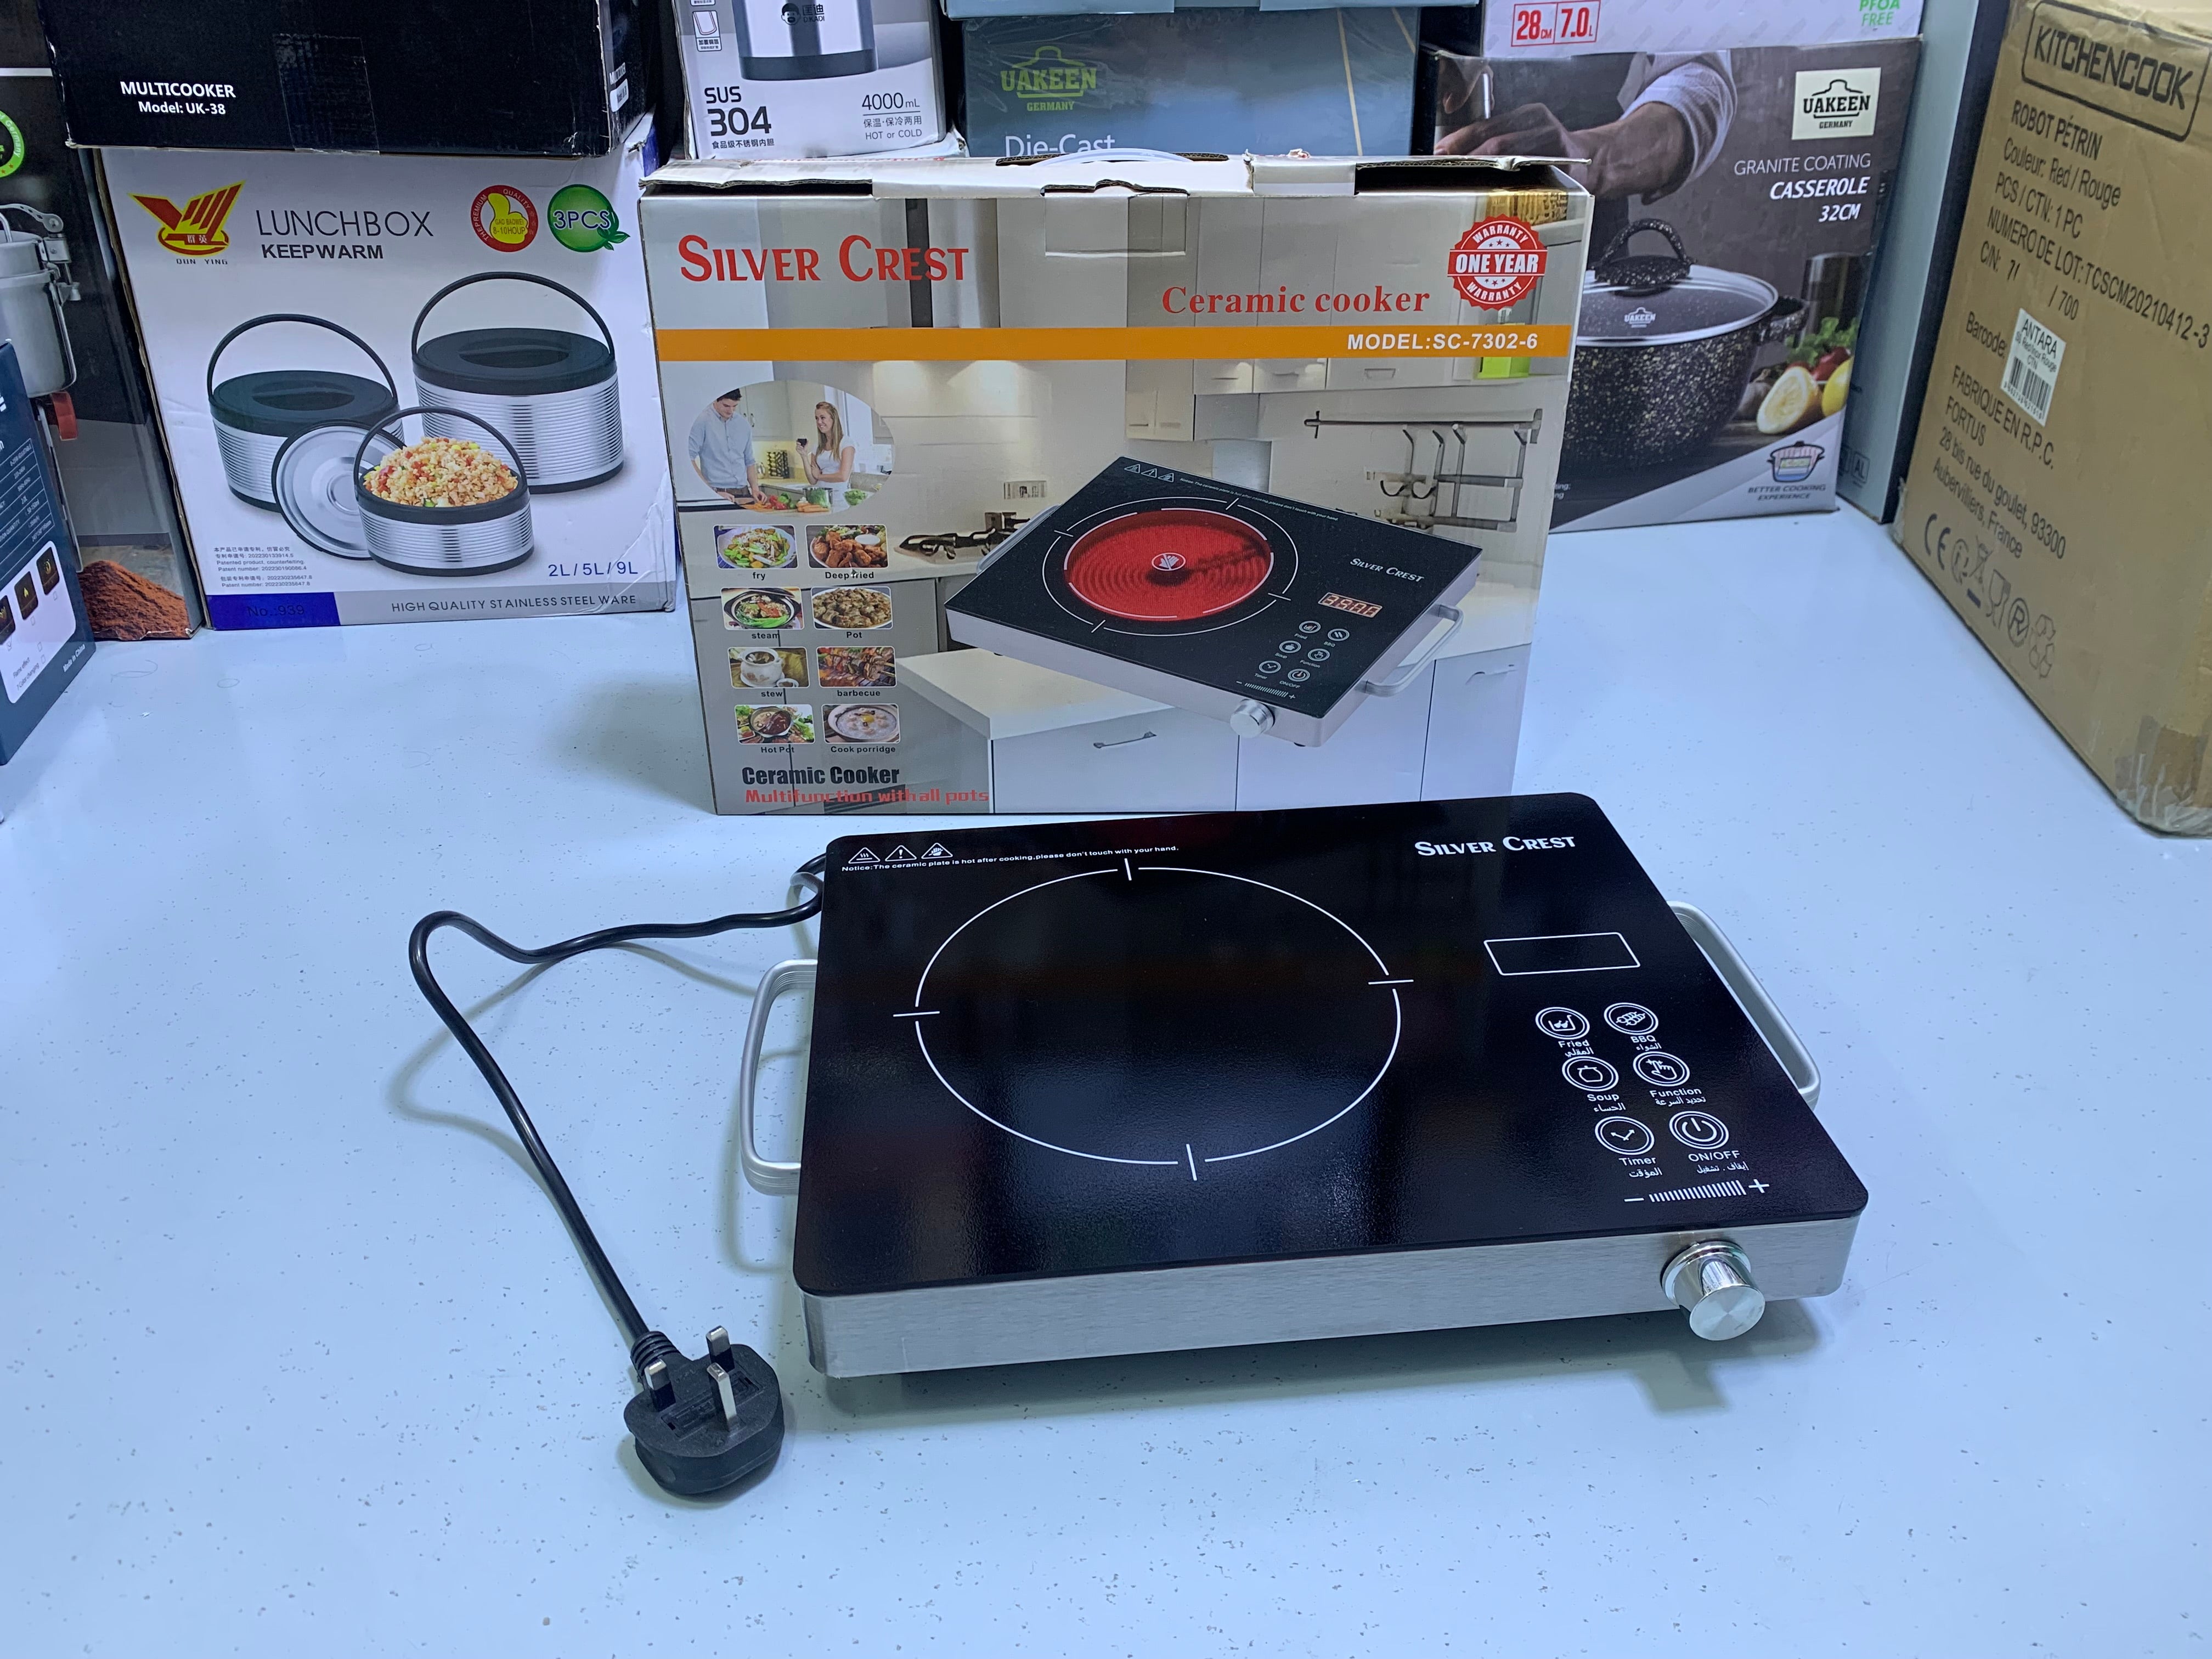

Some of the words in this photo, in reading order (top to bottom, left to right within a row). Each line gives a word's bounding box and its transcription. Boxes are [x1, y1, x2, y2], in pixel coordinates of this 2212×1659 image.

[1862, 12, 1894, 26] FREE
[2034, 25, 2193, 110] KITCHENCOOK
[1001, 68, 1097, 91] UAKEEN
[120, 81, 236, 98] MULTICOOKER
[704, 86, 741, 104] SUS
[138, 101, 184, 113] Model:
[185, 103, 226, 115] UK-38
[1027, 101, 1074, 111] GERMANY
[1803, 95, 1871, 114] UAKEEN
[709, 106, 771, 136] 304
[864, 116, 922, 127] 保温·保冷两用
[1819, 120, 1853, 128] GERMANY
[2011, 100, 2055, 138] ROBOT
[2054, 115, 2102, 160] PÉTRIN
[712, 138, 775, 149] 食品级不锈钢内胆
[866, 131, 883, 139] HOT
[898, 129, 922, 137] COLD
[1005, 134, 1115, 157] Die-Cast
[1734, 157, 1801, 175] GRANITE
[1804, 153, 1871, 171] COATING
[2004, 137, 2046, 178] Couleur:
[2050, 157, 2072, 188] Red
[2079, 169, 2121, 210] Rouge
[1770, 177, 1870, 200] CASSEROLE
[503, 189, 531, 209] QUALITY
[1995, 172, 2019, 203] PCS
[2025, 189, 2053, 223] CTN:
[2055, 204, 2063, 228] 1
[2063, 208, 2083, 239] PC
[554, 210, 611, 229] 3PCS
[1819, 203, 1861, 222] 32CM
[256, 210, 433, 236] LUNCHBOX
[1472, 224, 1528, 243] WARRANTY
[262, 243, 383, 259] KEEPWARM
[678, 235, 821, 281] SILVER
[839, 235, 969, 282] CREST
[1455, 253, 1491, 273] ONE
[1494, 254, 1539, 273] YEAR
[1987, 206, 2037, 253] NUMERO
[2036, 235, 2056, 266] DE
[2055, 246, 2084, 283] LOT:
[2085, 262, 2210, 348] TCSCM20210412-3
[1162, 286, 1308, 314] Ceramic
[1316, 286, 1430, 312] cooker
[1466, 281, 1521, 301] WARRANTY
[2059, 290, 2079, 320] 700
[1348, 333, 1538, 350] MODEL:SC-7302-6
[2022, 318, 2057, 359] ANTARA
[1945, 396, 1986, 447] FORTUS
[1953, 365, 2004, 424] FABRIQUE
[2003, 408, 2021, 438] EN
[2021, 422, 2053, 470] R.P.C.
[1783, 484, 1826, 492] COOKING
[1966, 456, 1981, 480] rue
[1982, 469, 1995, 493] du
[1994, 484, 2027, 530] goulet,
[2030, 511, 2066, 560] 93300
[1987, 511, 2023, 558] France
[752, 571, 766, 581] fry
[825, 572, 849, 580] Deep
[1350, 558, 1384, 572] SILVER
[1386, 567, 1424, 582] CREST
[392, 602, 425, 612] HIGH
[429, 600, 485, 611] QUALITY
[561, 596, 595, 606] STEEL
[598, 595, 636, 605] WARE
[1300, 659, 1321, 668] Function
[837, 689, 881, 697] barbecue
[1279, 680, 1301, 689] ON/OFF
[856, 745, 896, 754] porridge
[742, 766, 825, 785] Ceramic
[830, 766, 900, 784] Cooker
[746, 789, 872, 803] Multifunction
[878, 788, 916, 802] with
[918, 788, 940, 802] all
[945, 789, 989, 805] pots
[1414, 841, 1497, 856] SILVER
[1502, 836, 1576, 851] CREST
[1558, 1040, 1590, 1048] Fried
[1630, 1035, 1656, 1043] BBQ
[1649, 1088, 1702, 1097] Function
[1619, 1156, 1657, 1166] Timer
[1688, 1150, 1740, 1162] ON/OFF
